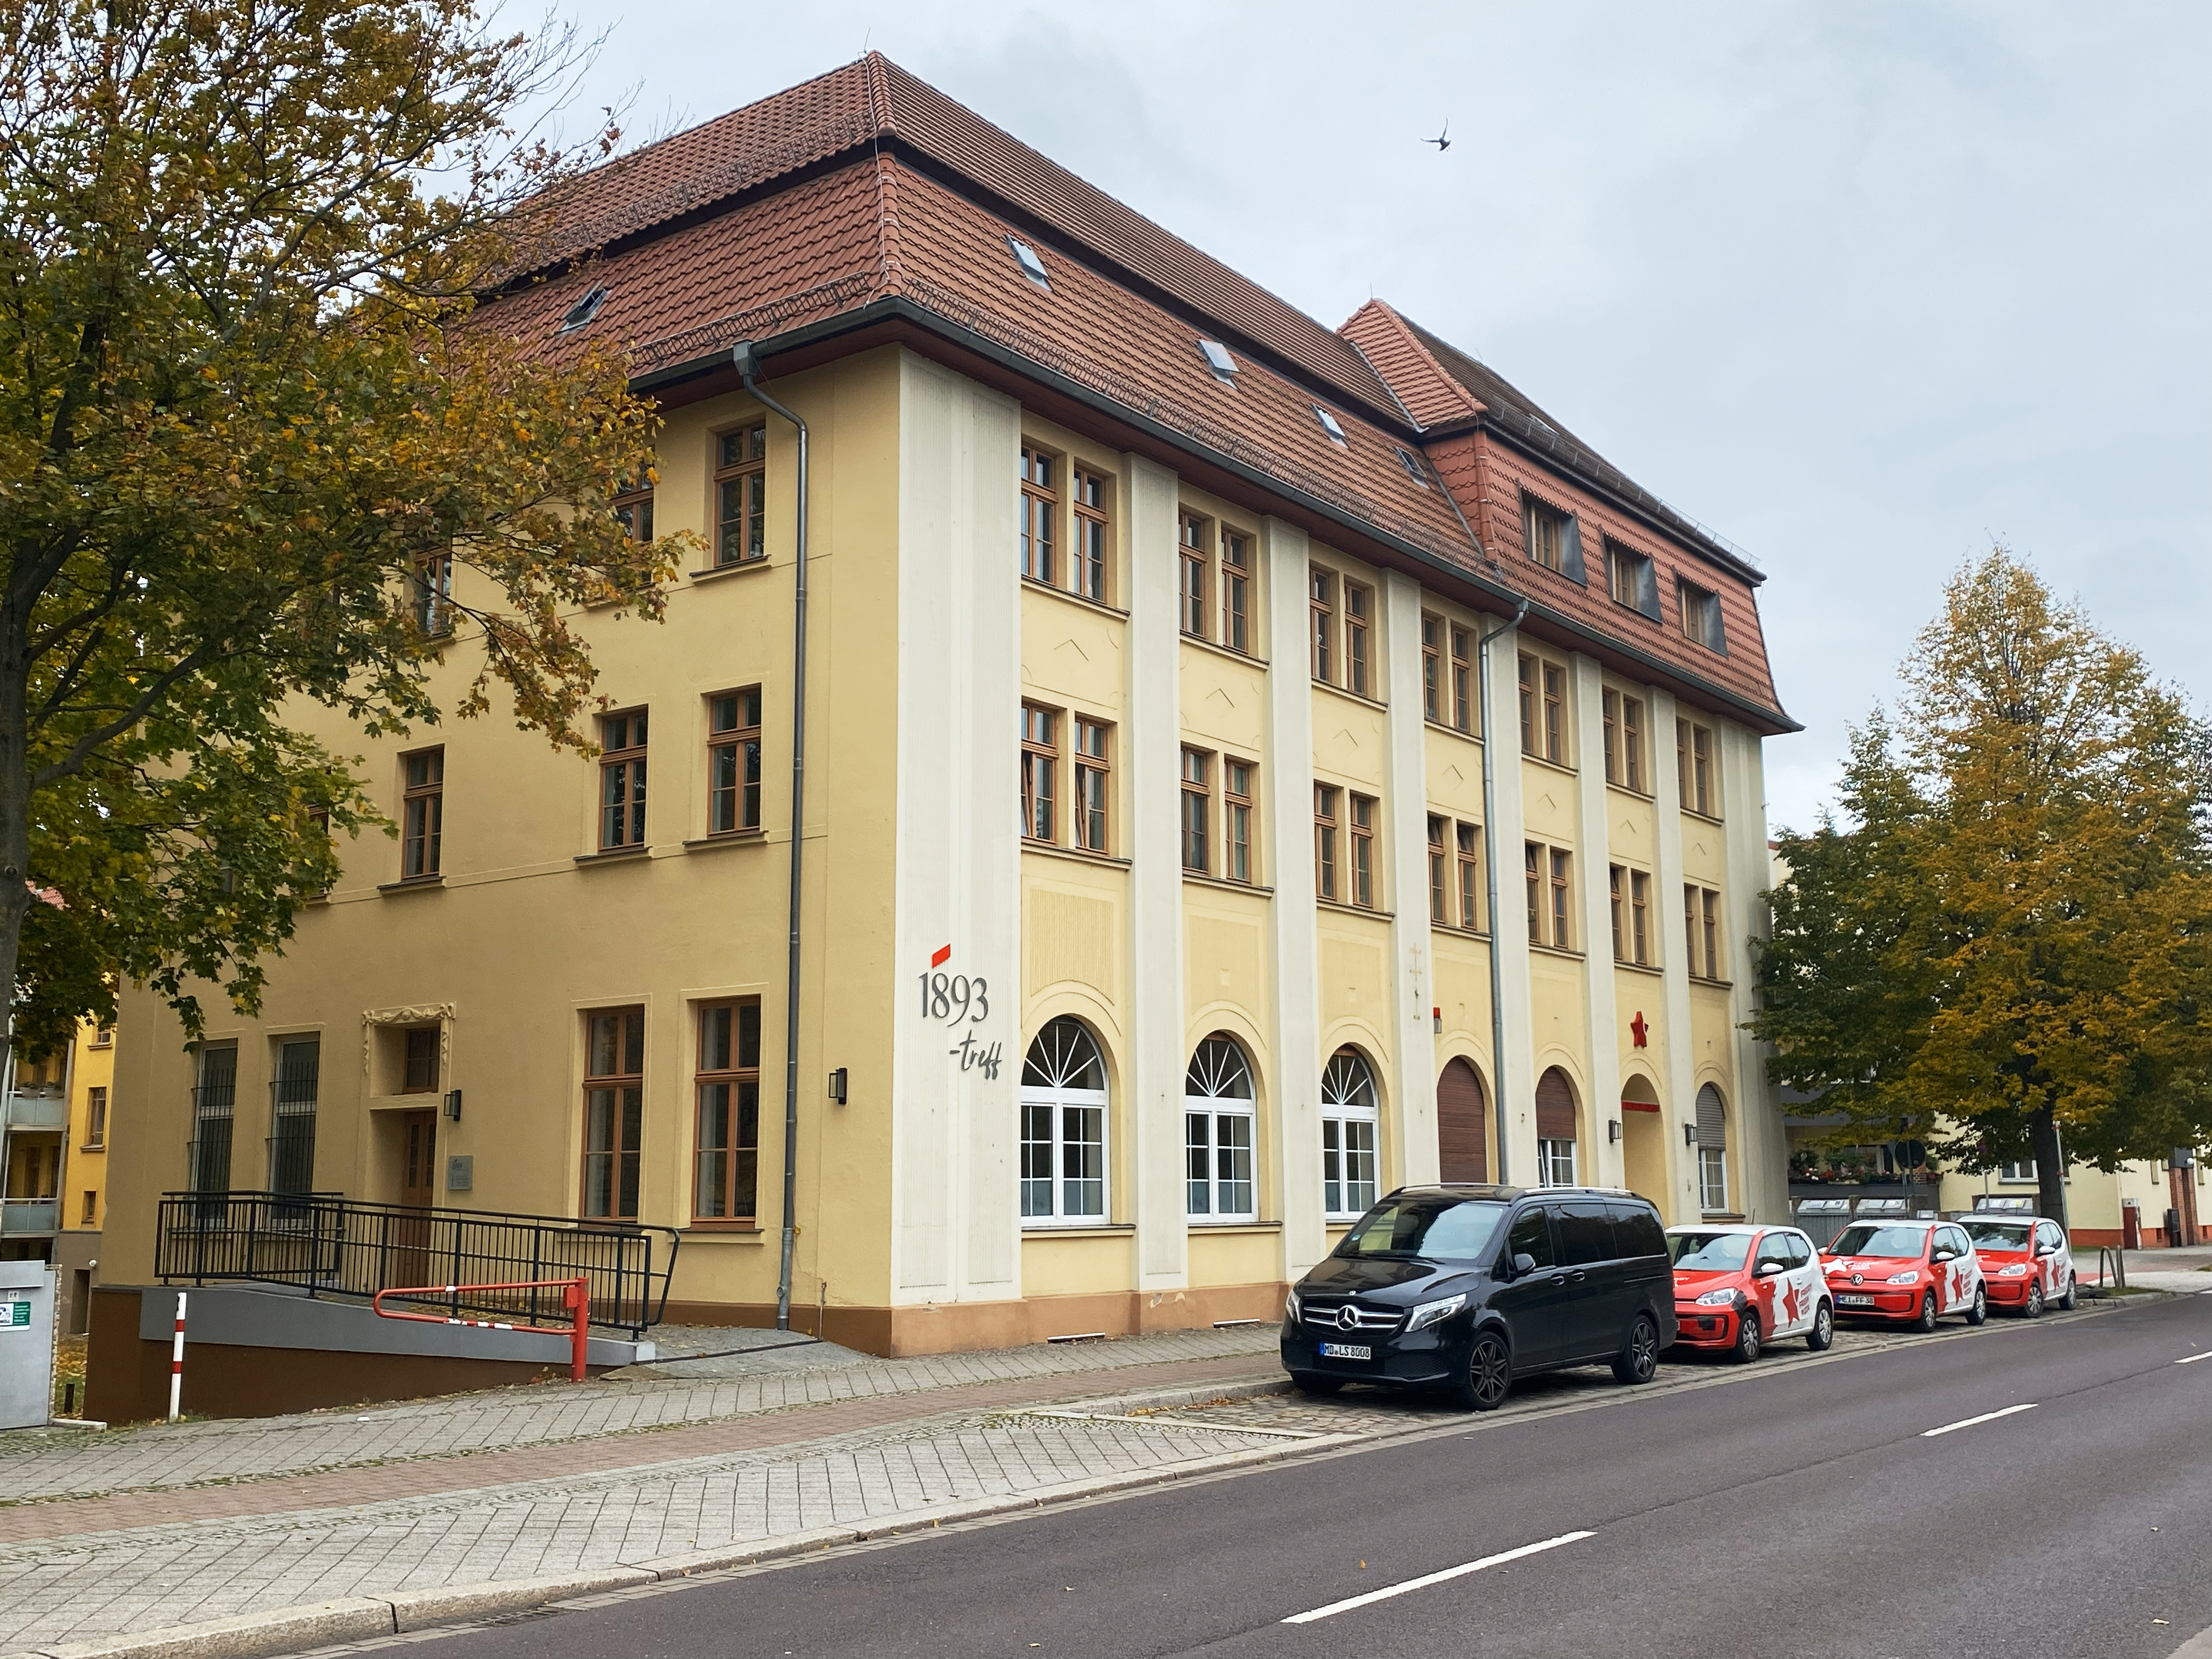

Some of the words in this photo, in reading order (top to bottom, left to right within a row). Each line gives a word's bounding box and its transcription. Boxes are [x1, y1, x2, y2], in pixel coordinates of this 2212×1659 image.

[918, 972, 989, 1027] 1893
[949, 1029, 1002, 1080] -treff
[1324, 1344, 1334, 1355] MD
[1339, 1346, 1349, 1356] LS
[1351, 1347, 1370, 1358] 8008
